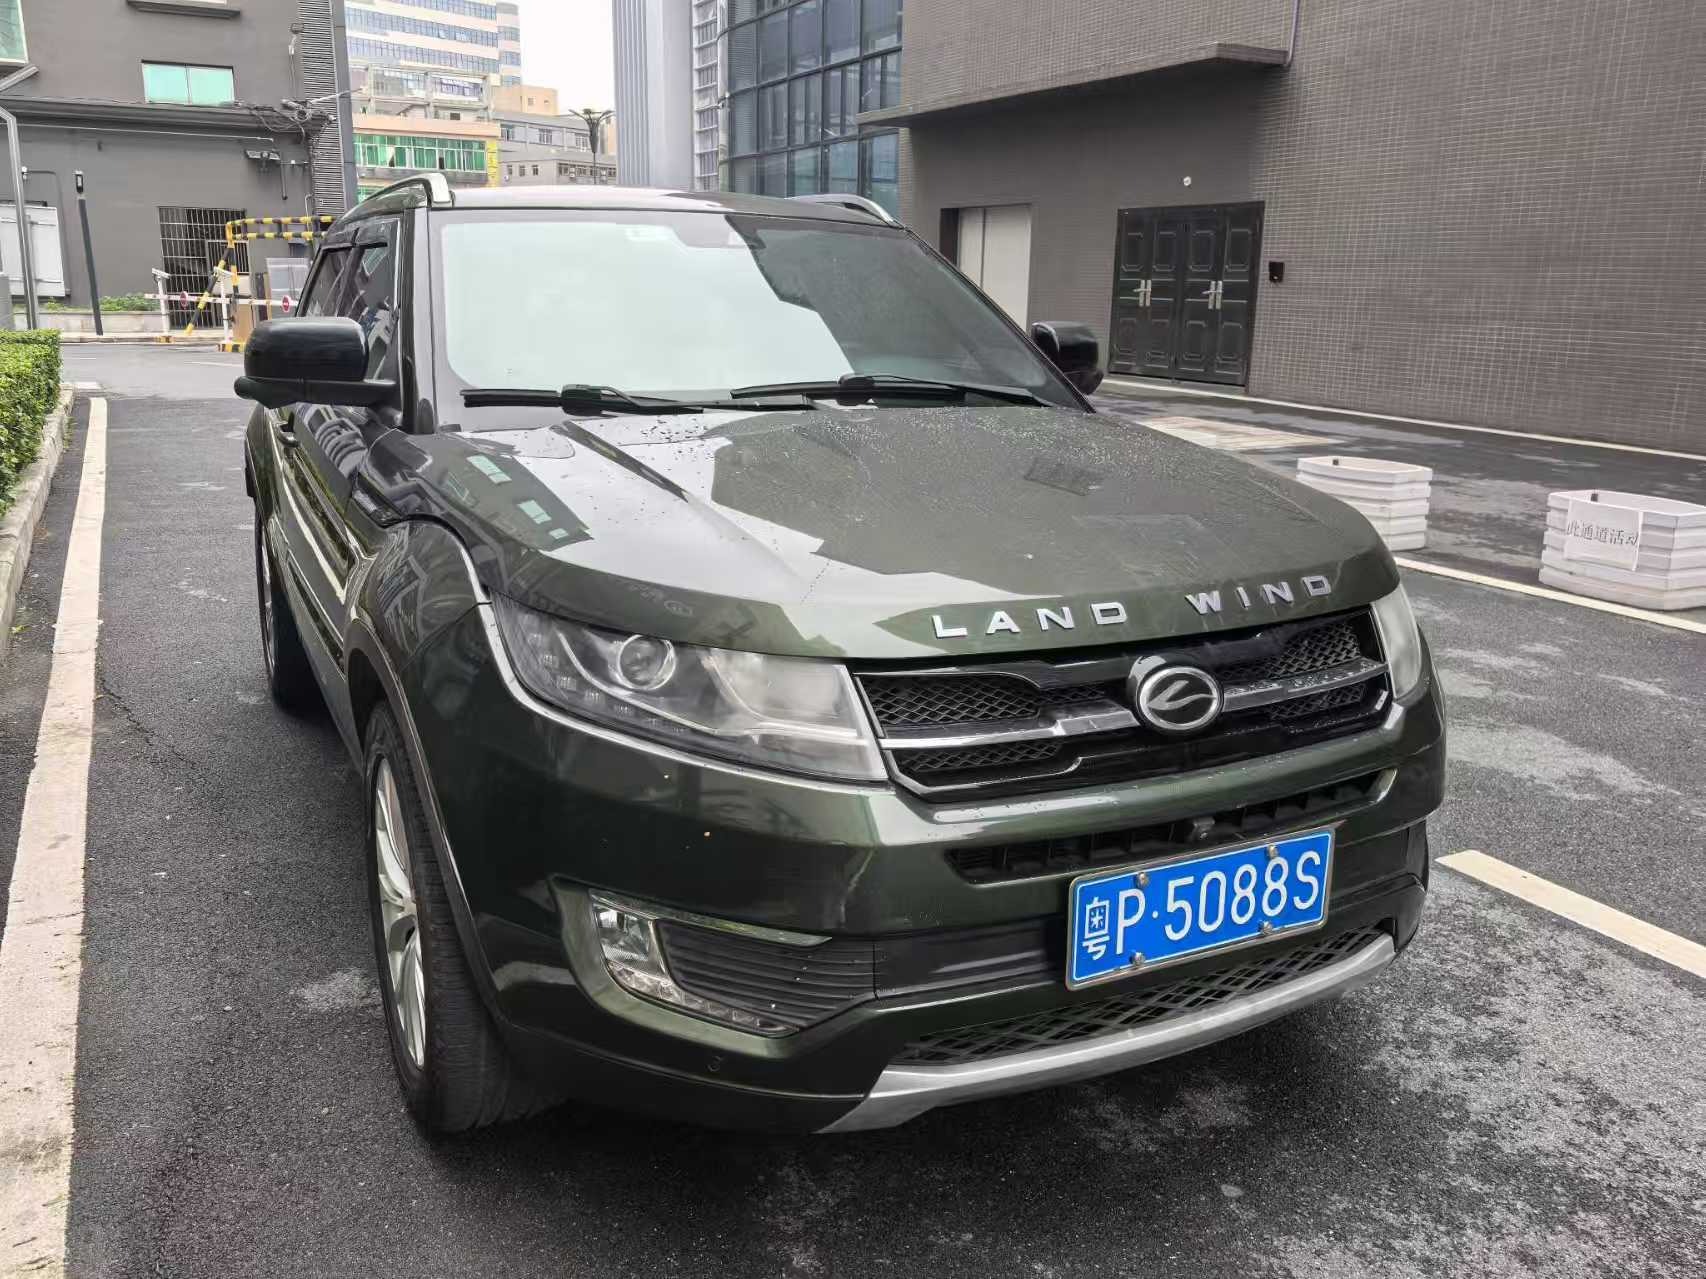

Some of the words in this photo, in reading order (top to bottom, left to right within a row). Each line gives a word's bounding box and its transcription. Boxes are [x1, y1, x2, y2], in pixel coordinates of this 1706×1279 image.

[931, 601, 1127, 639] LAND
[1185, 575, 1332, 615] WIND
[1082, 850, 1321, 961] 粤P·5088S
